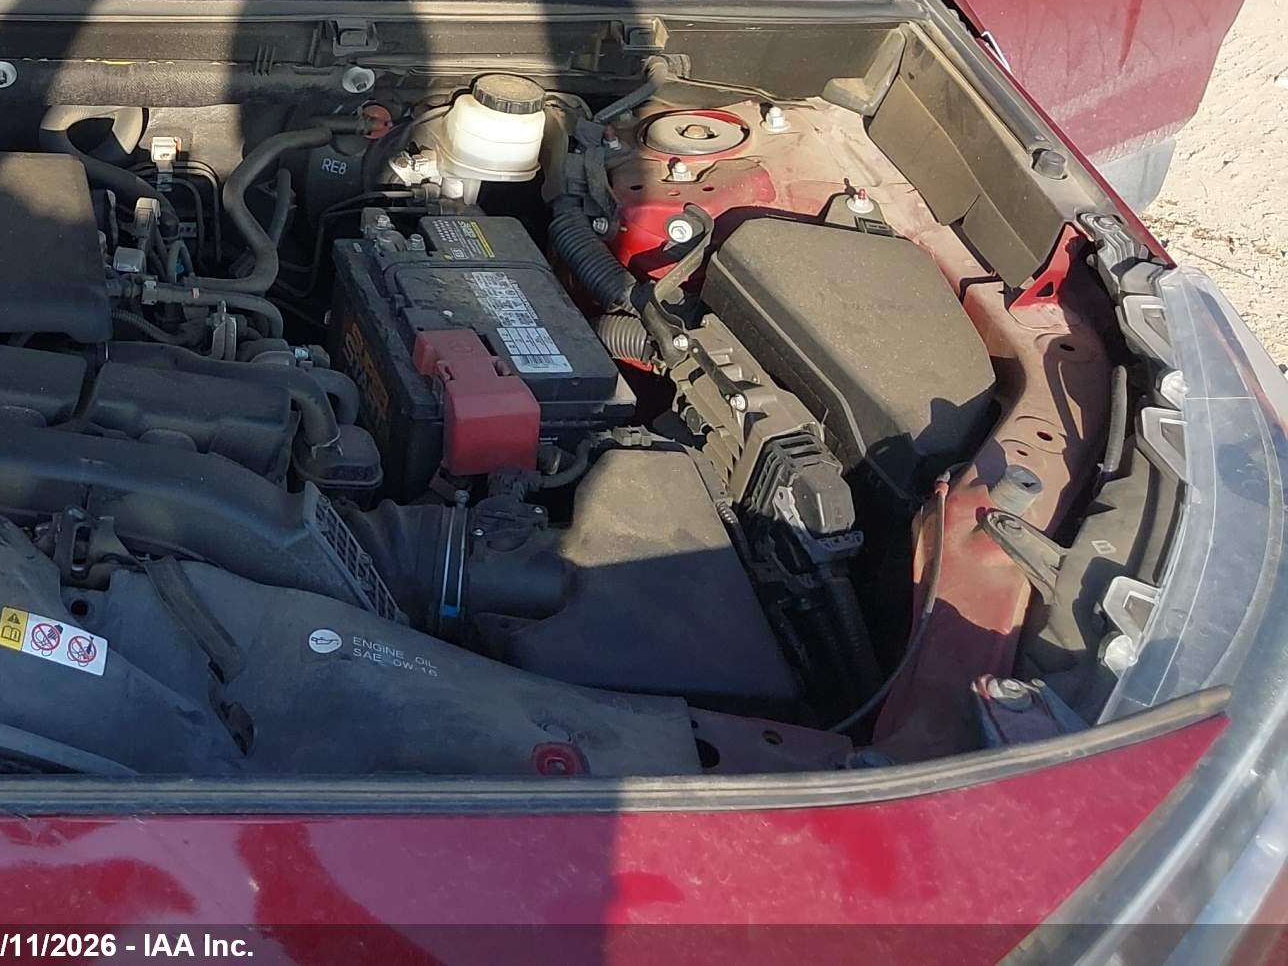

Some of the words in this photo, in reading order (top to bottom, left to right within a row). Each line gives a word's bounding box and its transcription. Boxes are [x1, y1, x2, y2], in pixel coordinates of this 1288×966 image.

[322, 158, 347, 175] RE8
[352, 636, 404, 659] ENGINE
[415, 656, 438, 670] OIL
[352, 647, 383, 662] SAE
